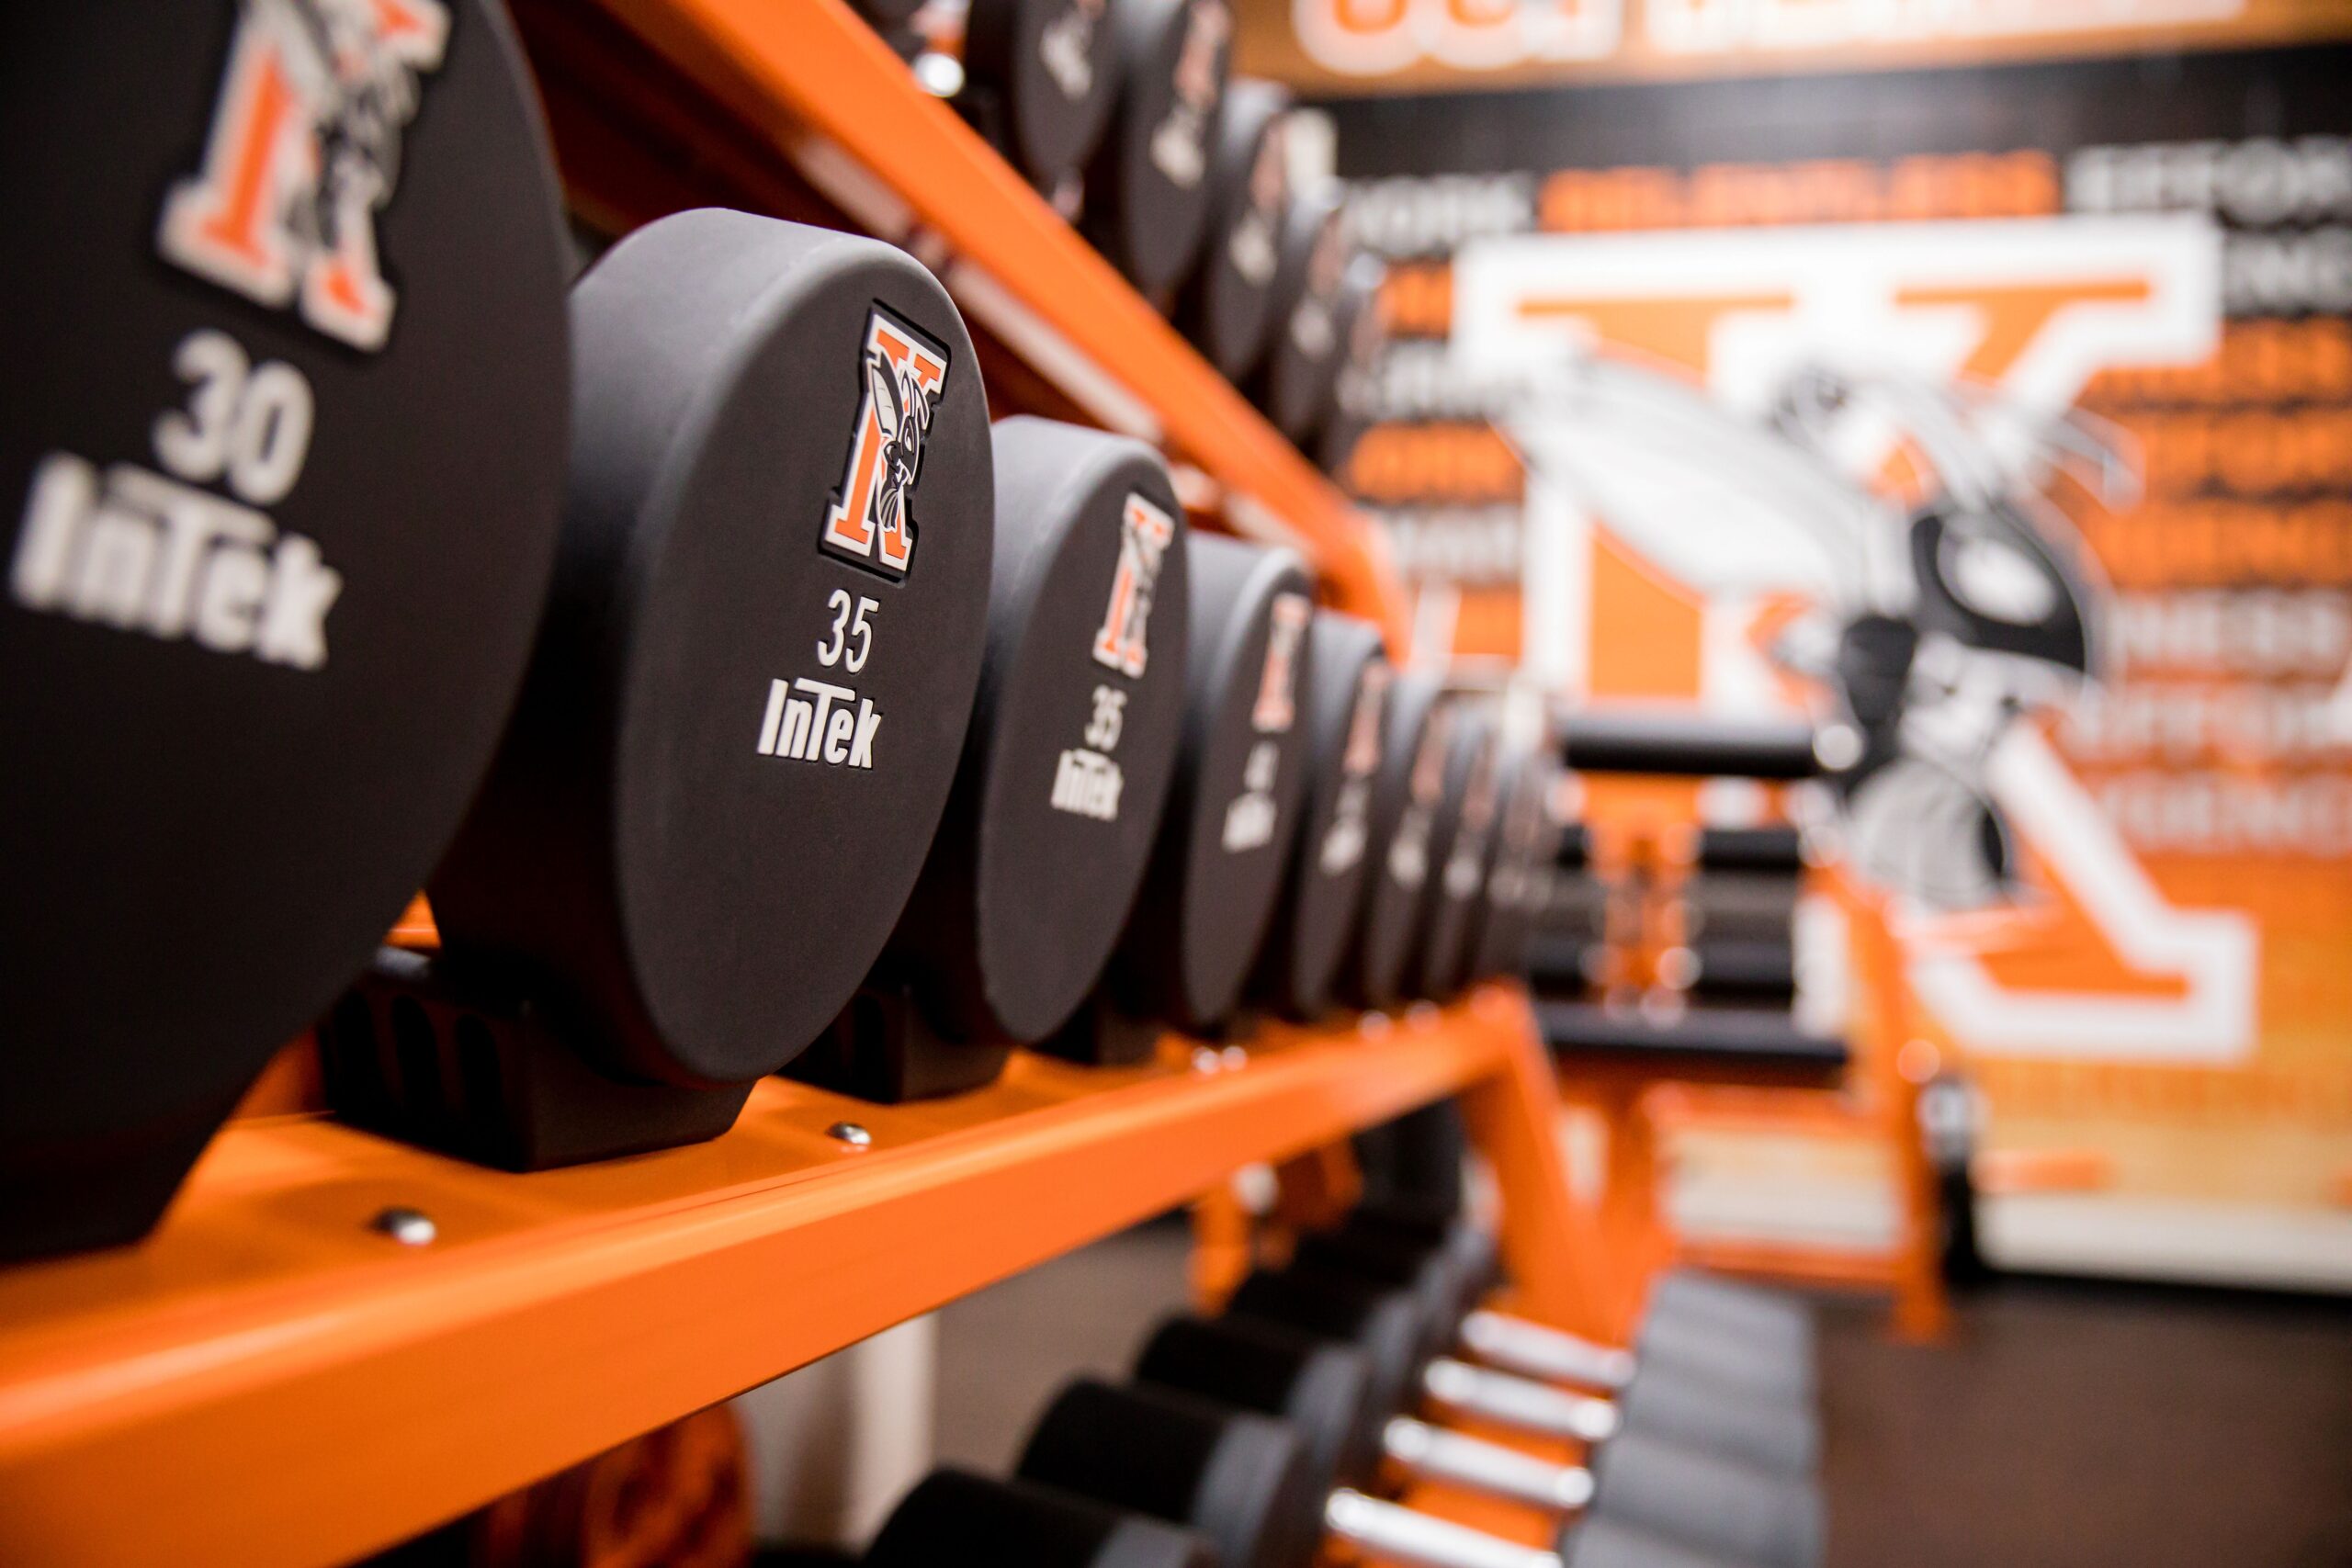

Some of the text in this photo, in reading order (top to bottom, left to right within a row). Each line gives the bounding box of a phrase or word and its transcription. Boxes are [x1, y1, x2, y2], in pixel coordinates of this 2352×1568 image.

[153, 326, 315, 505] 30
[7, 450, 344, 672] InTek
[817, 588, 879, 674] 35
[757, 677, 882, 770] InTek
[1084, 683, 1127, 751] 35
